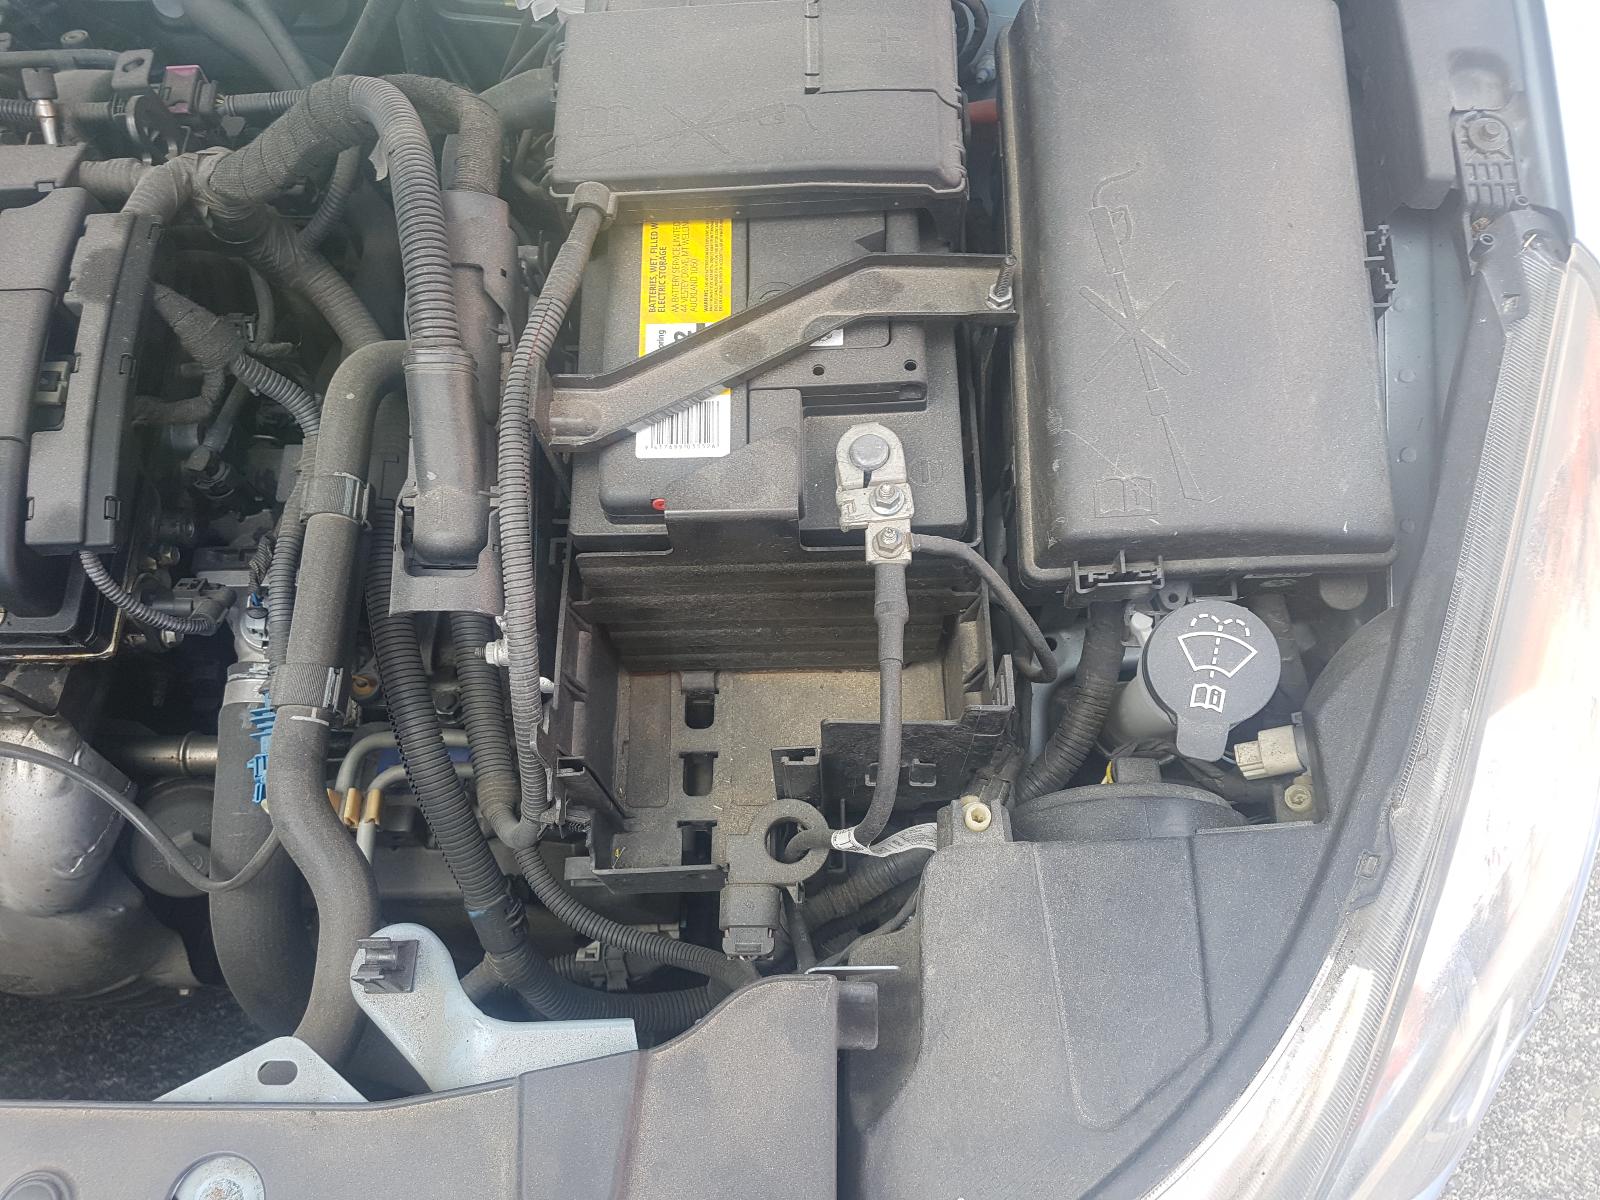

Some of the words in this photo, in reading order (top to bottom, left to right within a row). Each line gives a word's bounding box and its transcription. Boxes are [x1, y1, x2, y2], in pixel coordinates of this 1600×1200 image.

[650, 231, 658, 253] FILLED
[650, 255, 659, 272] WET,
[672, 248, 680, 273] SERVICE
[649, 274, 658, 312] BATTERIES,
[690, 276, 698, 312] AUCKLAND
